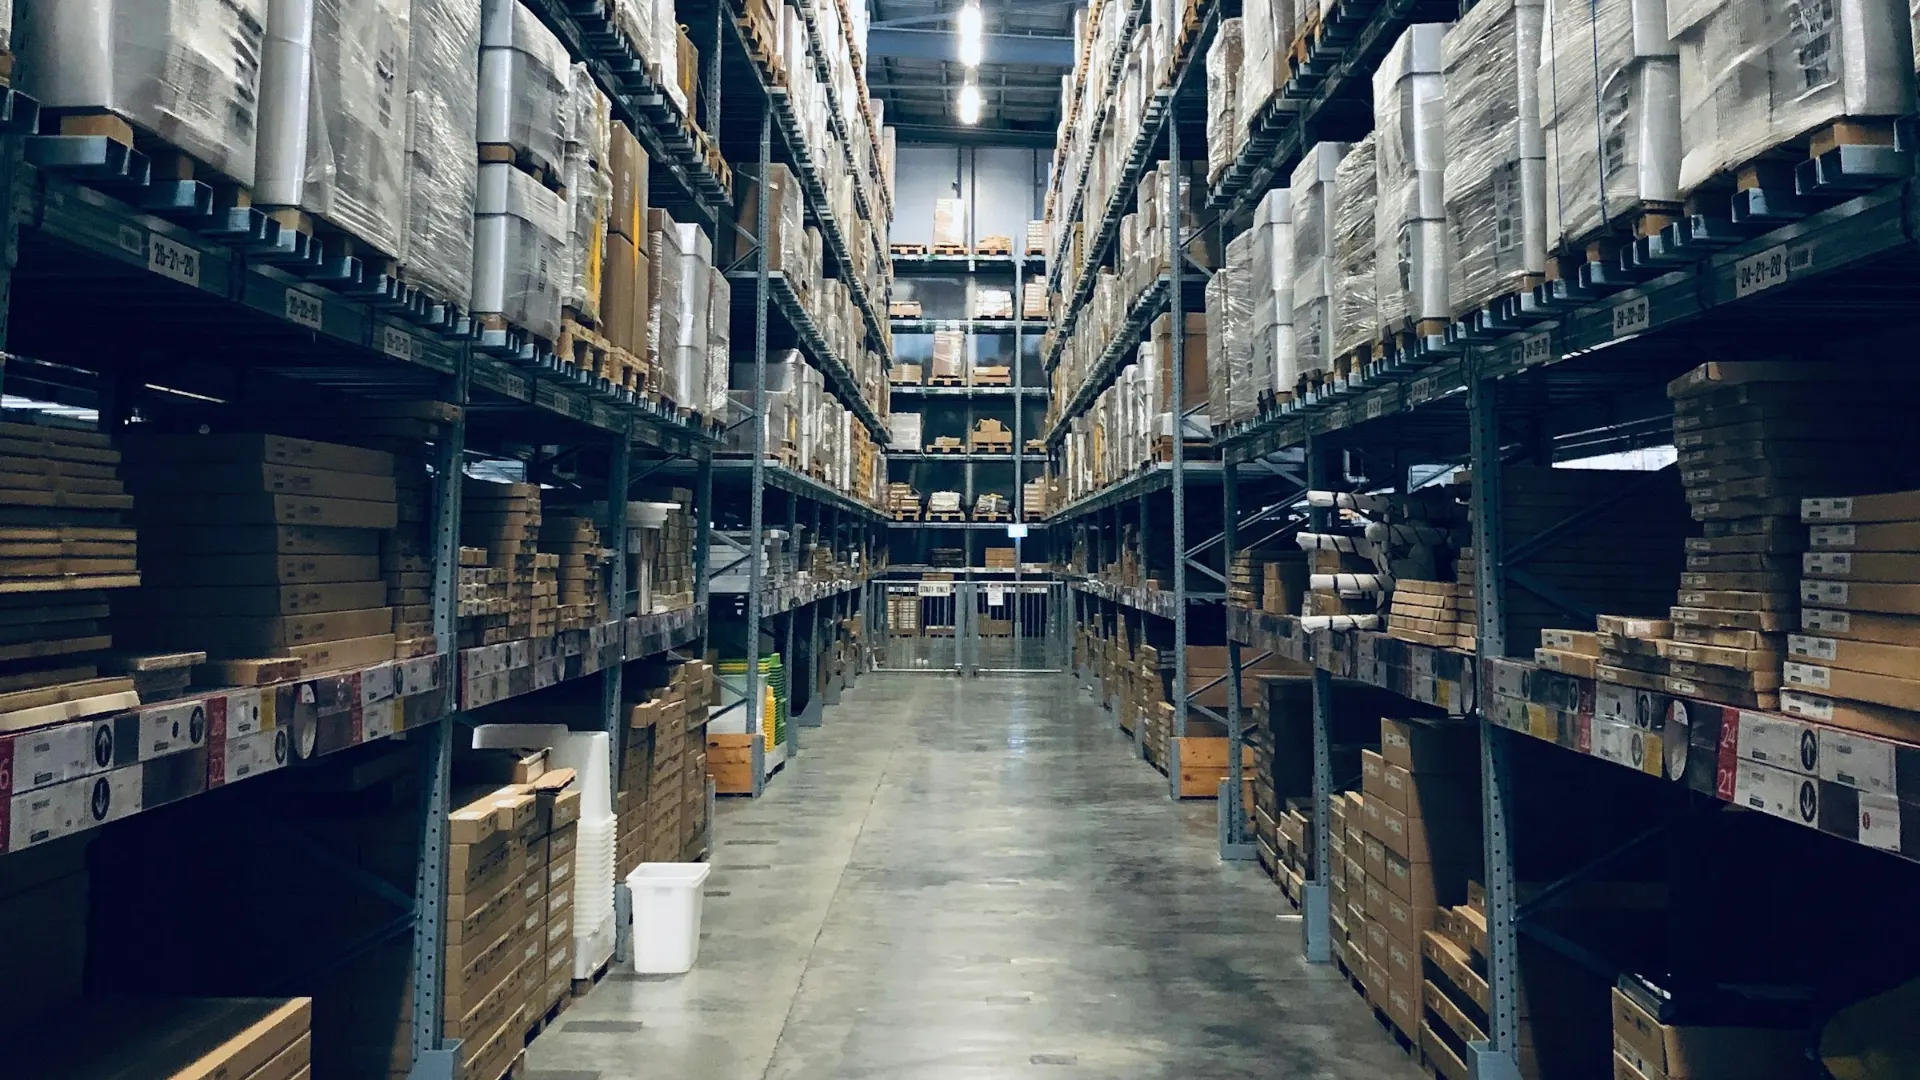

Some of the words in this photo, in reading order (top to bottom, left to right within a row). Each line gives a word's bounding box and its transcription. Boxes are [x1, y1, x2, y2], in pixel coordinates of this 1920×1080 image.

[1741, 253, 1782, 288] 24-21-20
[920, 585, 934, 593] STAFF
[936, 585, 949, 593] ONLY
[1721, 723, 1736, 749] 24
[1718, 768, 1733, 795] 21
